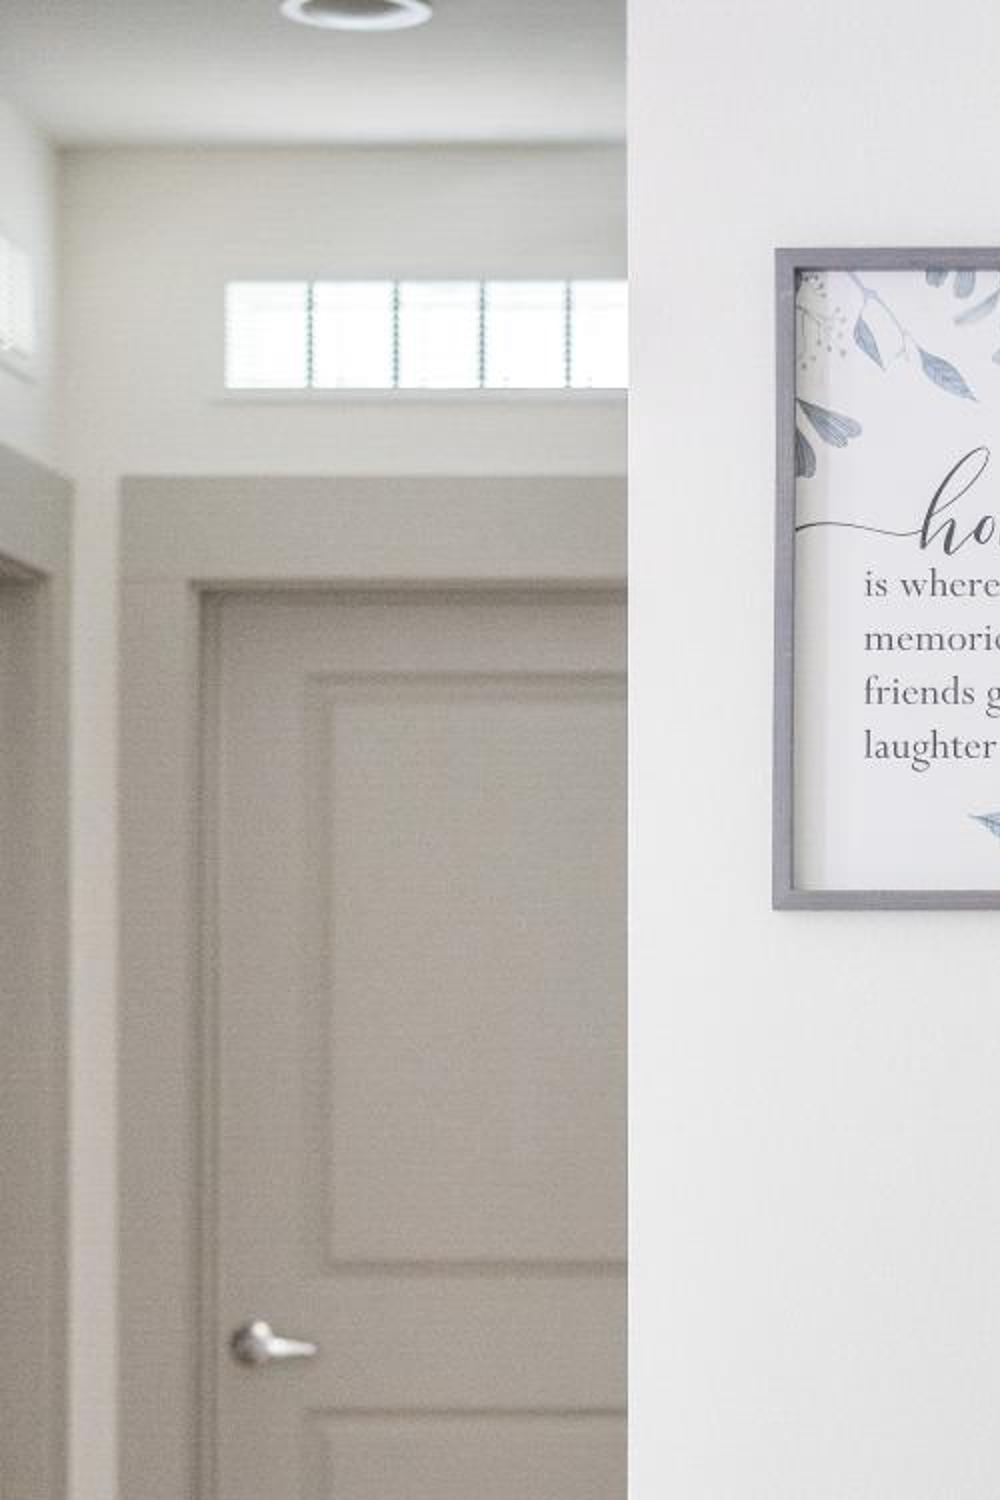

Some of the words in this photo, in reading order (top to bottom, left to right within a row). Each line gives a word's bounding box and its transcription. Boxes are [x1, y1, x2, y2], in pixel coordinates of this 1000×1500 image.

[864, 569, 888, 598] is
[900, 567, 1000, 598] where
[864, 675, 976, 706] friends
[864, 729, 998, 773] laughter
